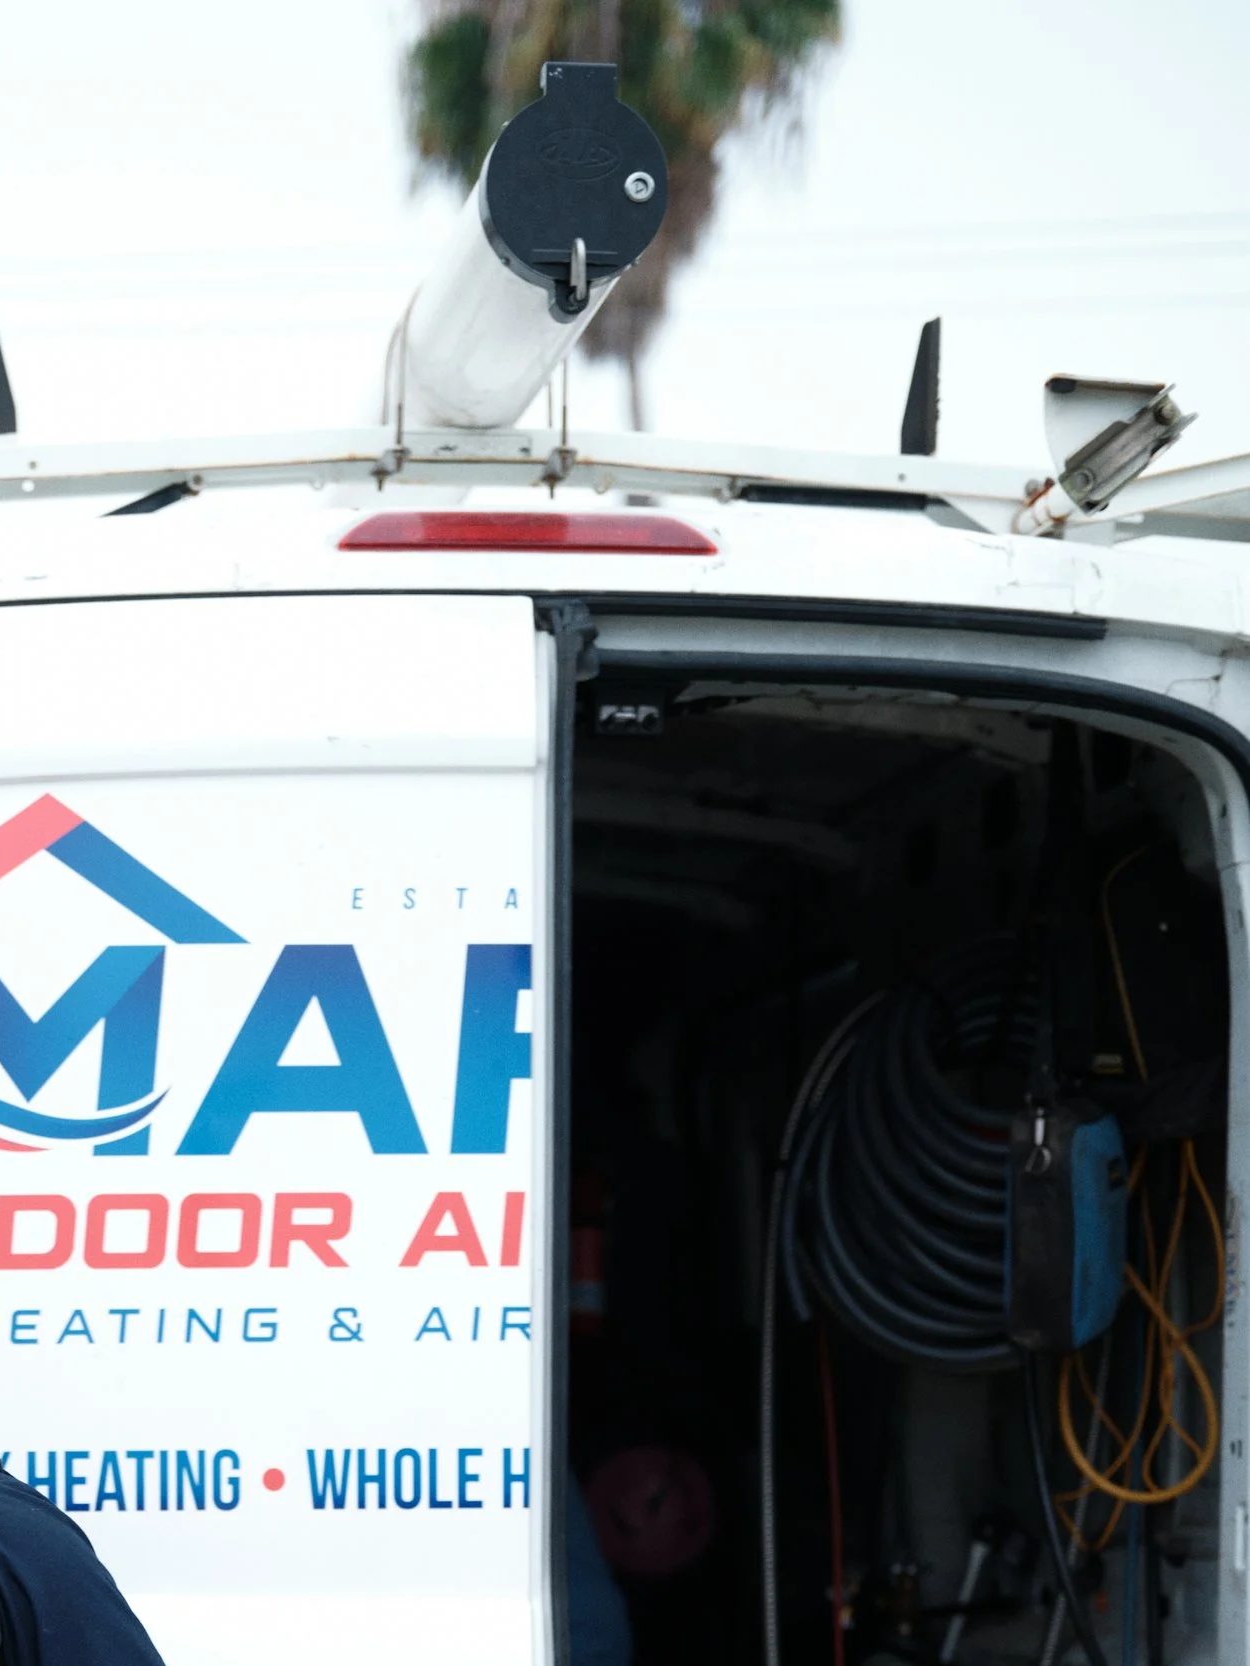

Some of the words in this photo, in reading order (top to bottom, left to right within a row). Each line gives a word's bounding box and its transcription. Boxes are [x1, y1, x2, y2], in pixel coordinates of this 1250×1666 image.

[399, 1191, 526, 1268] AI
[328, 1306, 364, 1343] &
[414, 1305, 532, 1342] AIR
[28, 1448, 242, 1512] HEATING
[306, 1447, 485, 1510] WHOLE
